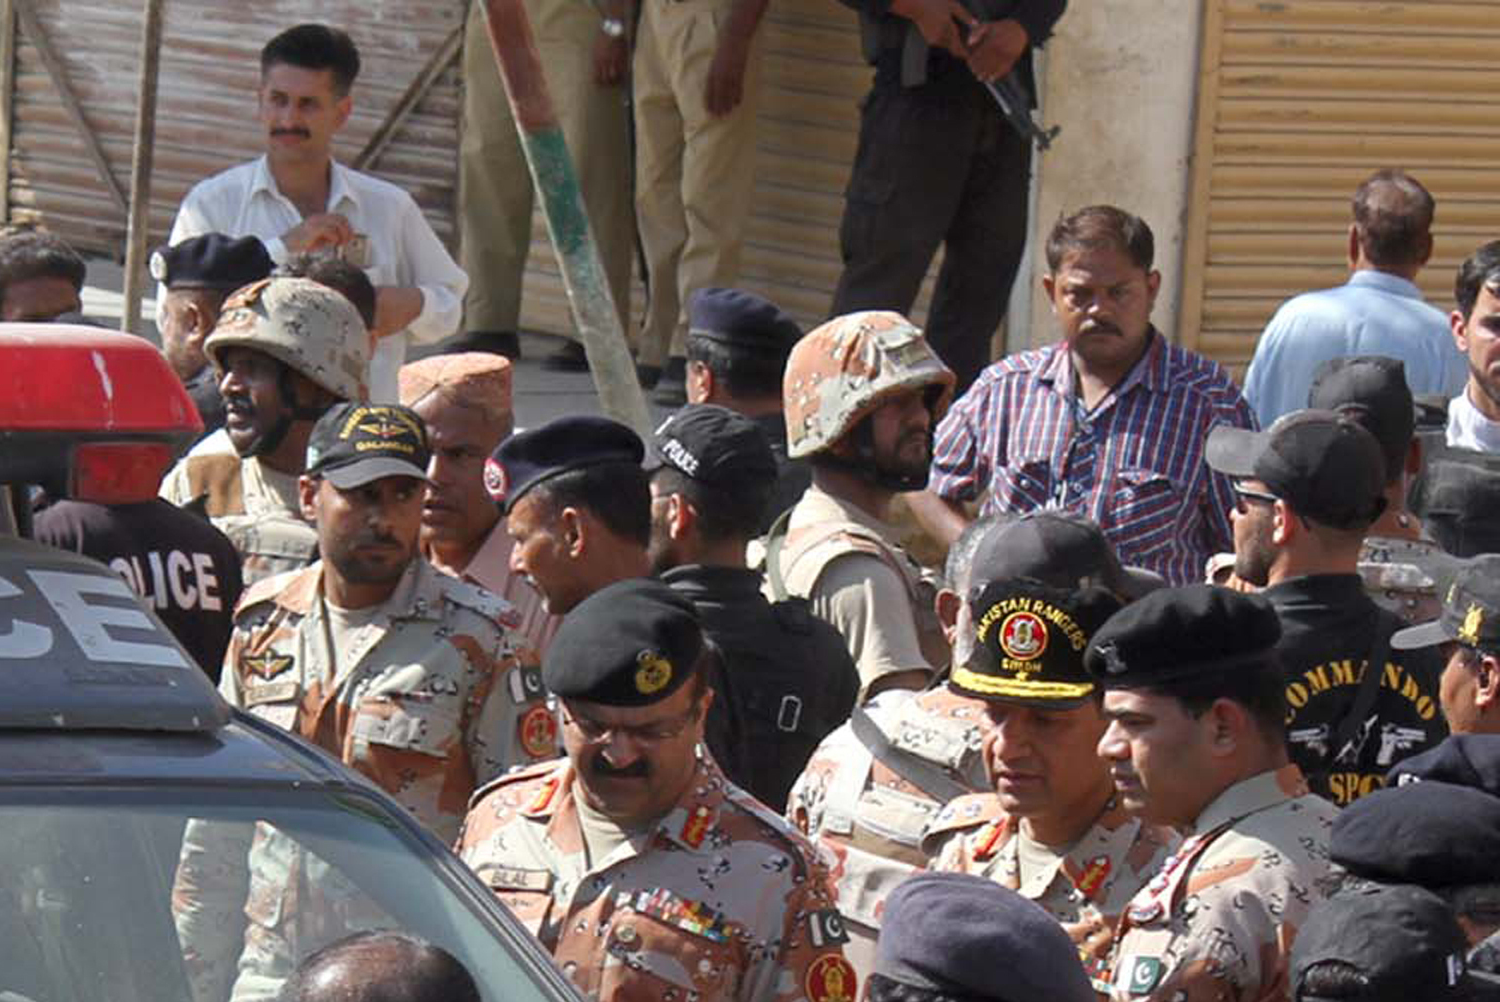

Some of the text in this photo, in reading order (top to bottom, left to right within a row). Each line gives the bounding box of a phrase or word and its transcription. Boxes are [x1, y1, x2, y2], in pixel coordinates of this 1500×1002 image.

[661, 438, 700, 478] POLICE
[109, 549, 222, 612] OLICE
[1032, 599, 1088, 651] RANGERS
